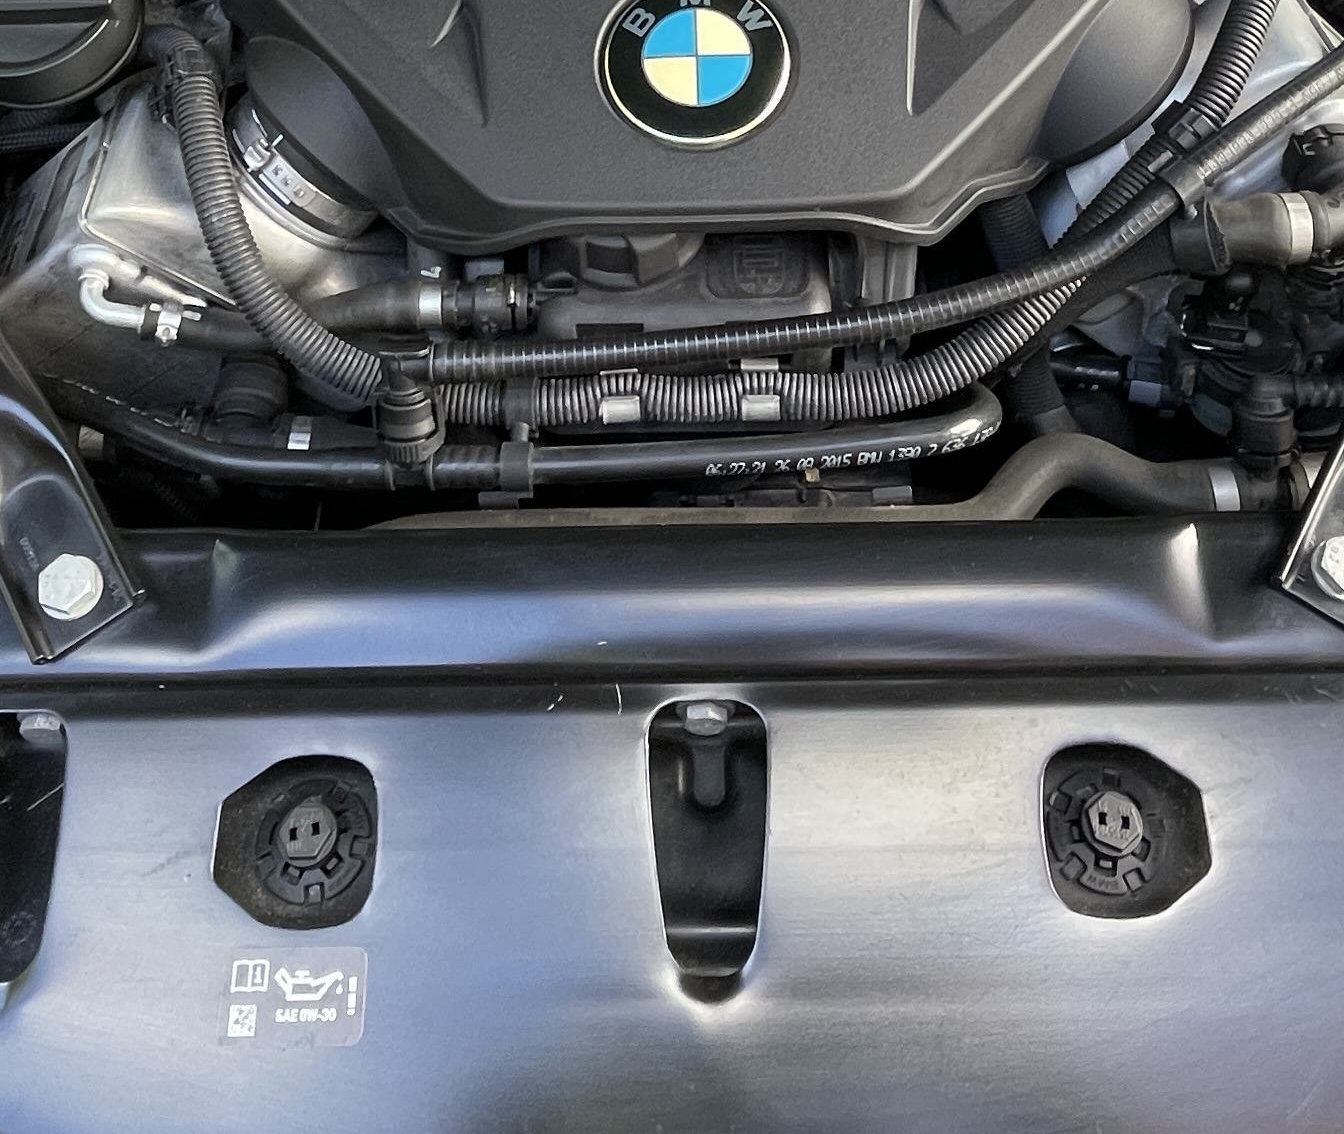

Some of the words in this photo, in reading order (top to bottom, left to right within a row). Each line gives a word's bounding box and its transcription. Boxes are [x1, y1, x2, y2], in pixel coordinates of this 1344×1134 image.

[819, 452, 852, 468] 2015
[857, 451, 882, 466] BMW
[274, 1007, 298, 1022] SAE
[299, 1007, 337, 1022] 0W-30
